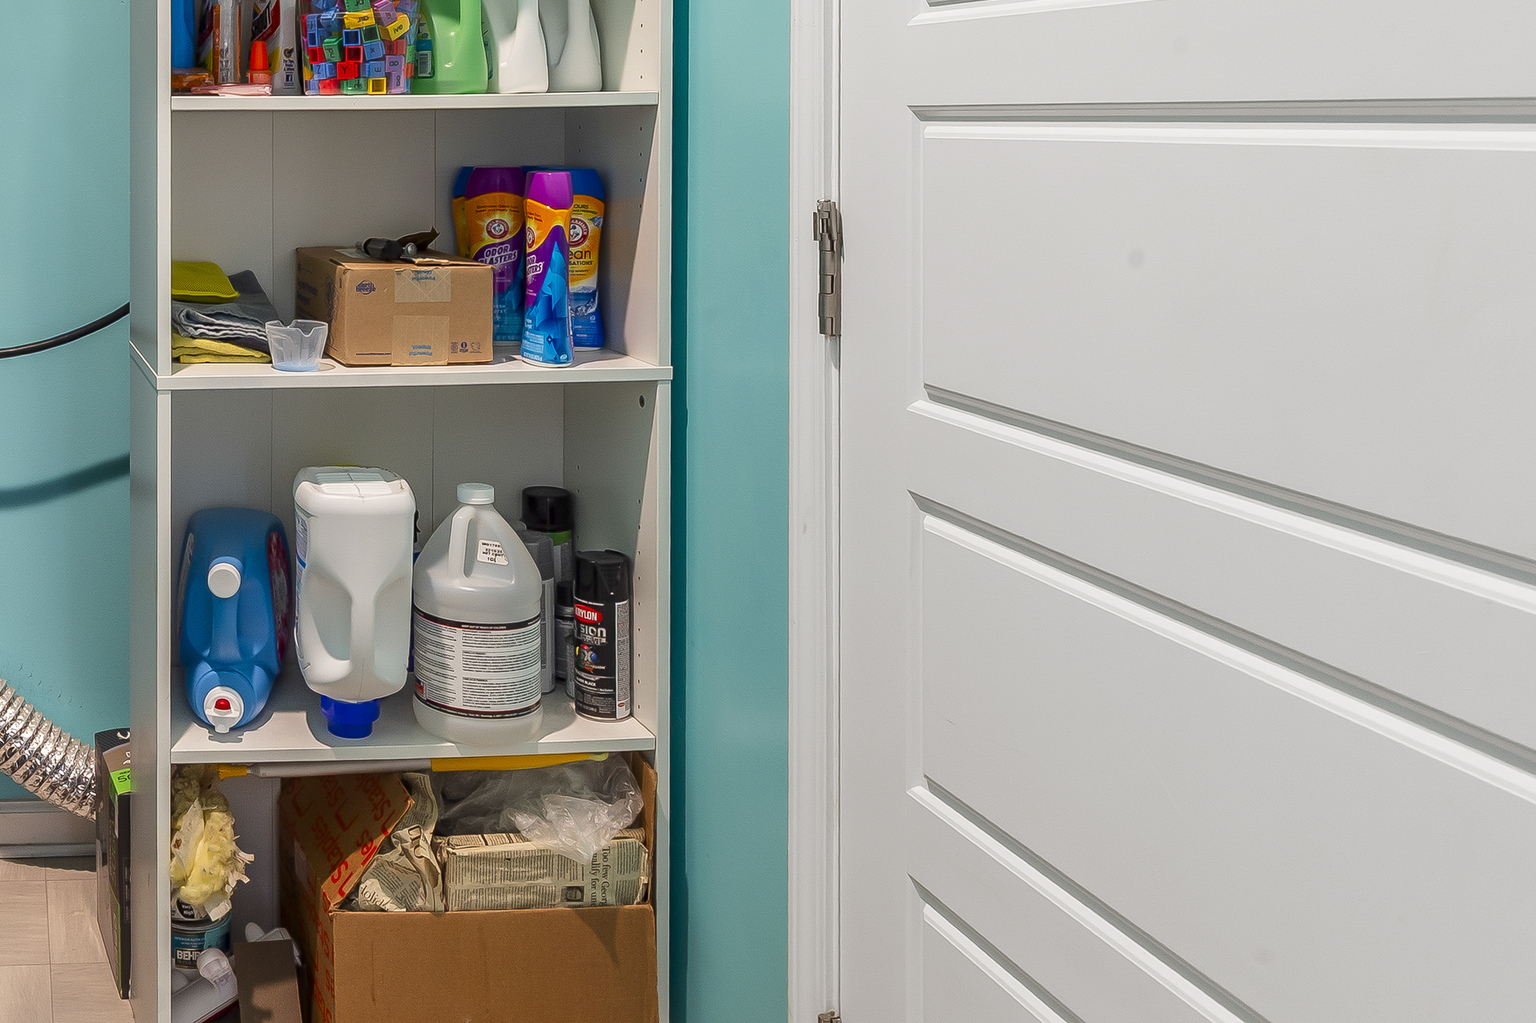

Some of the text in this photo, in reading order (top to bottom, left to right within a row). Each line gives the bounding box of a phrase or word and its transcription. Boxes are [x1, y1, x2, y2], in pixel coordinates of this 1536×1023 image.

[485, 245, 510, 258] ODOR
[569, 250, 592, 260] ean
[602, 846, 610, 862] Too
[590, 853, 601, 876] ualify
[602, 864, 611, 879] few
[591, 878, 600, 890] for
